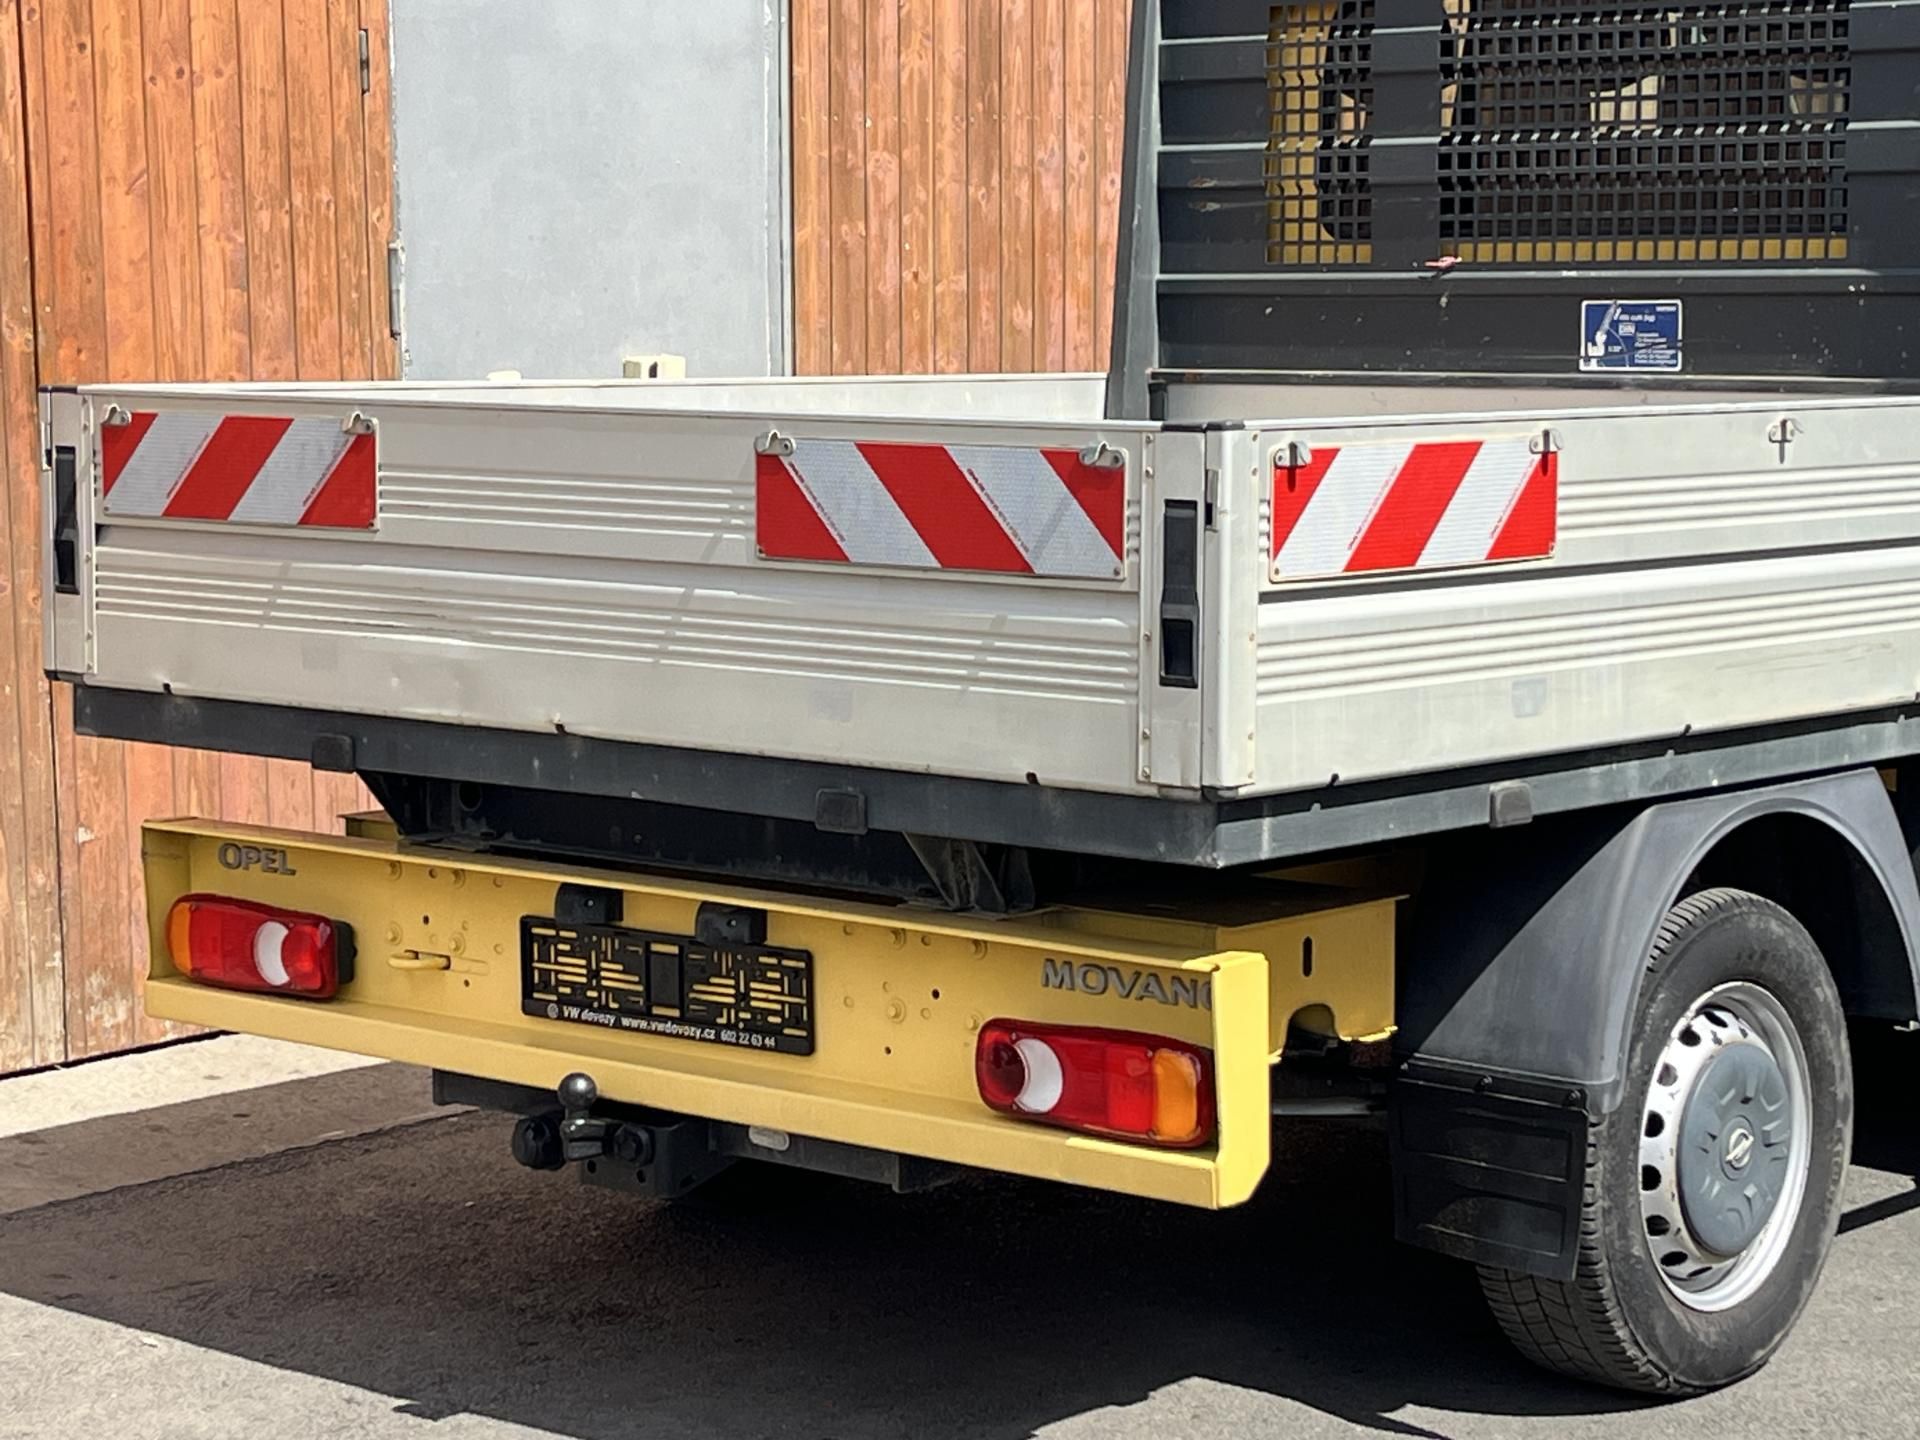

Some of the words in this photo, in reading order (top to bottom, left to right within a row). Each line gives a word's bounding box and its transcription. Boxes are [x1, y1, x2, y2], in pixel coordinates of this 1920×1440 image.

[218, 842, 297, 876] OPEL
[562, 1005, 581, 1019] VW
[581, 1008, 617, 1027] dovozy
[621, 1016, 716, 1040] www.vwdovozy.cz
[720, 1029, 737, 1043] 602
[738, 1031, 750, 1045] 22
[751, 1033, 763, 1047] 63
[764, 1036, 776, 1048] 44
